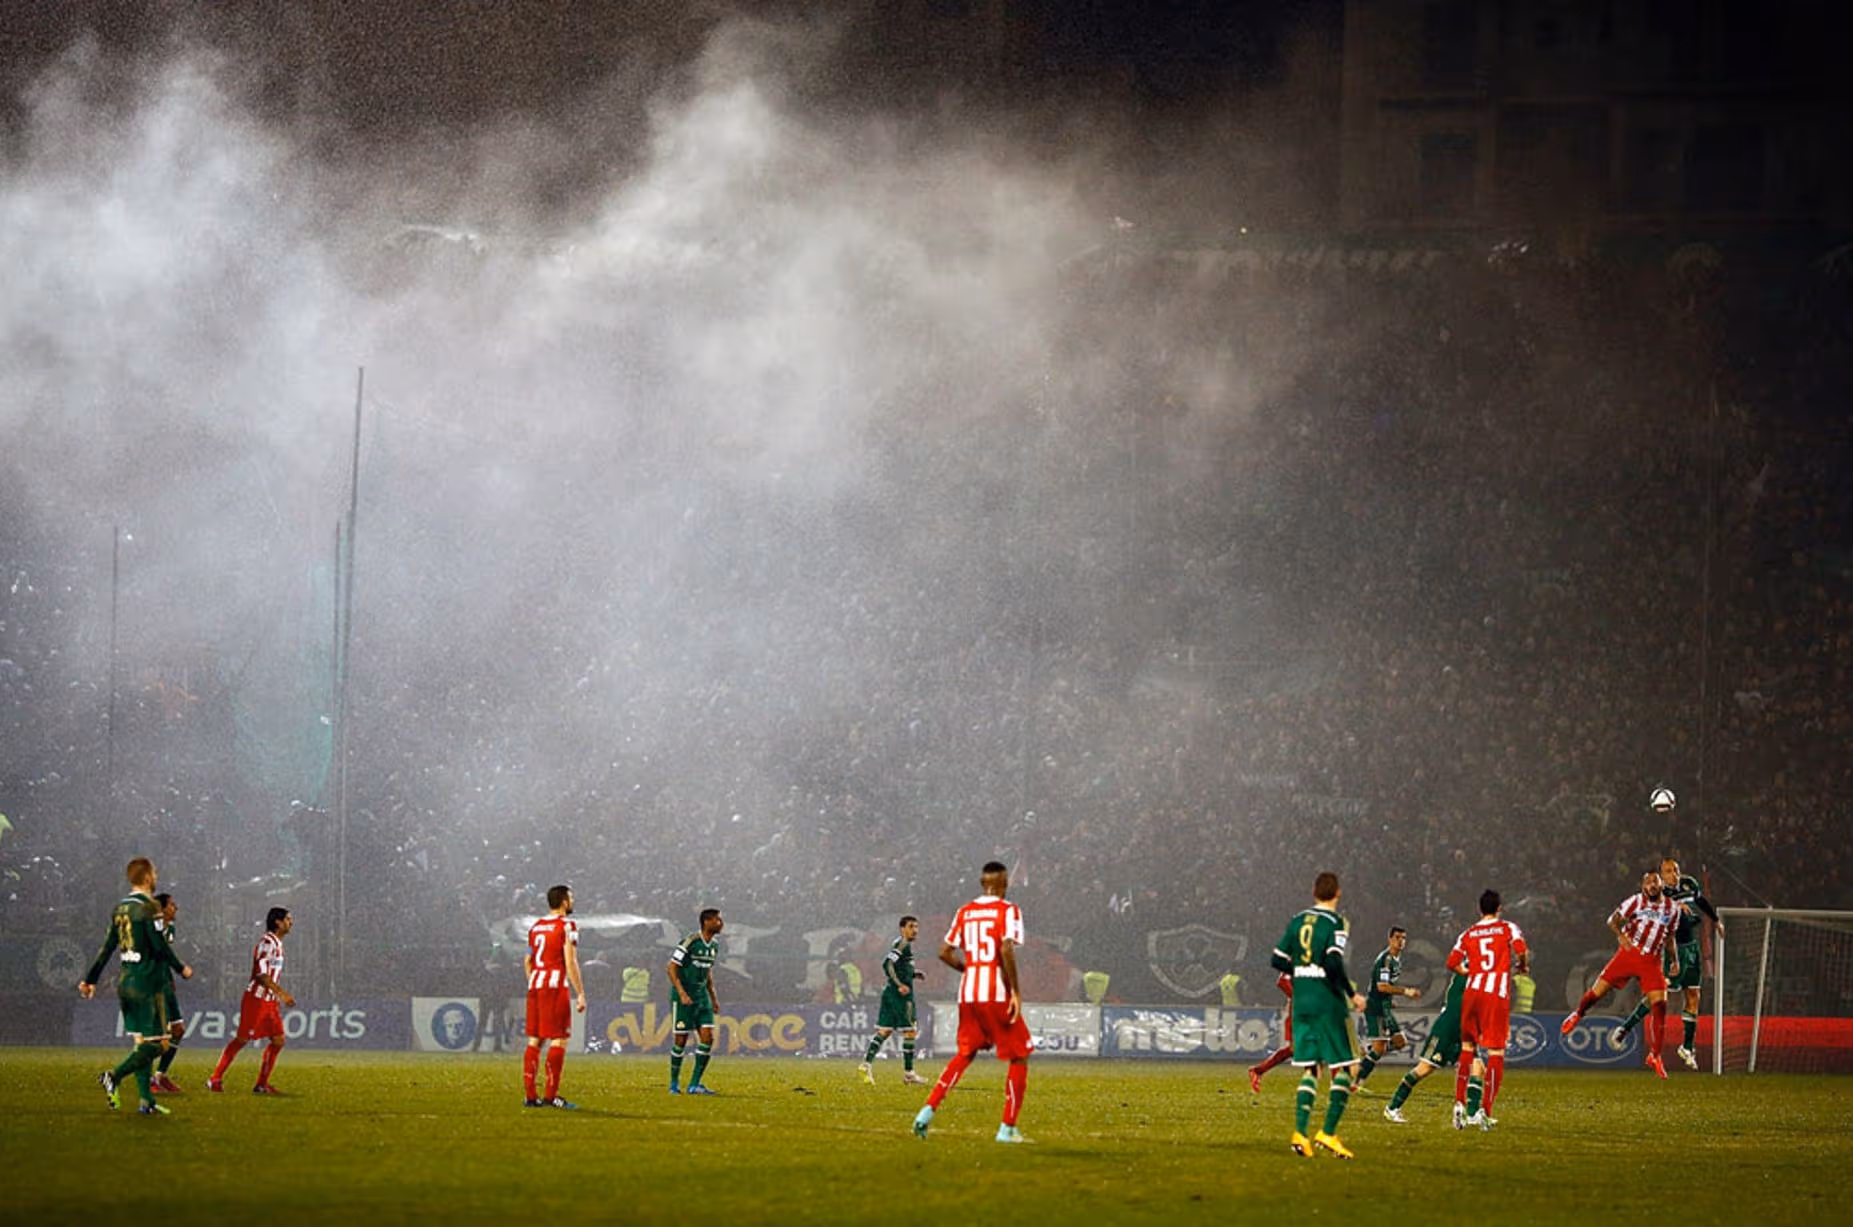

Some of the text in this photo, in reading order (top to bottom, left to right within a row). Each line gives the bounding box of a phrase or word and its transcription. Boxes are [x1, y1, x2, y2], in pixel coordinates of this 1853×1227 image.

[534, 933, 546, 968] 2
[964, 919, 996, 963] 45
[1299, 923, 1313, 963] 9
[1479, 937, 1495, 971] 5
[608, 1003, 806, 1052] avnce
[820, 1011, 868, 1030] CAR
